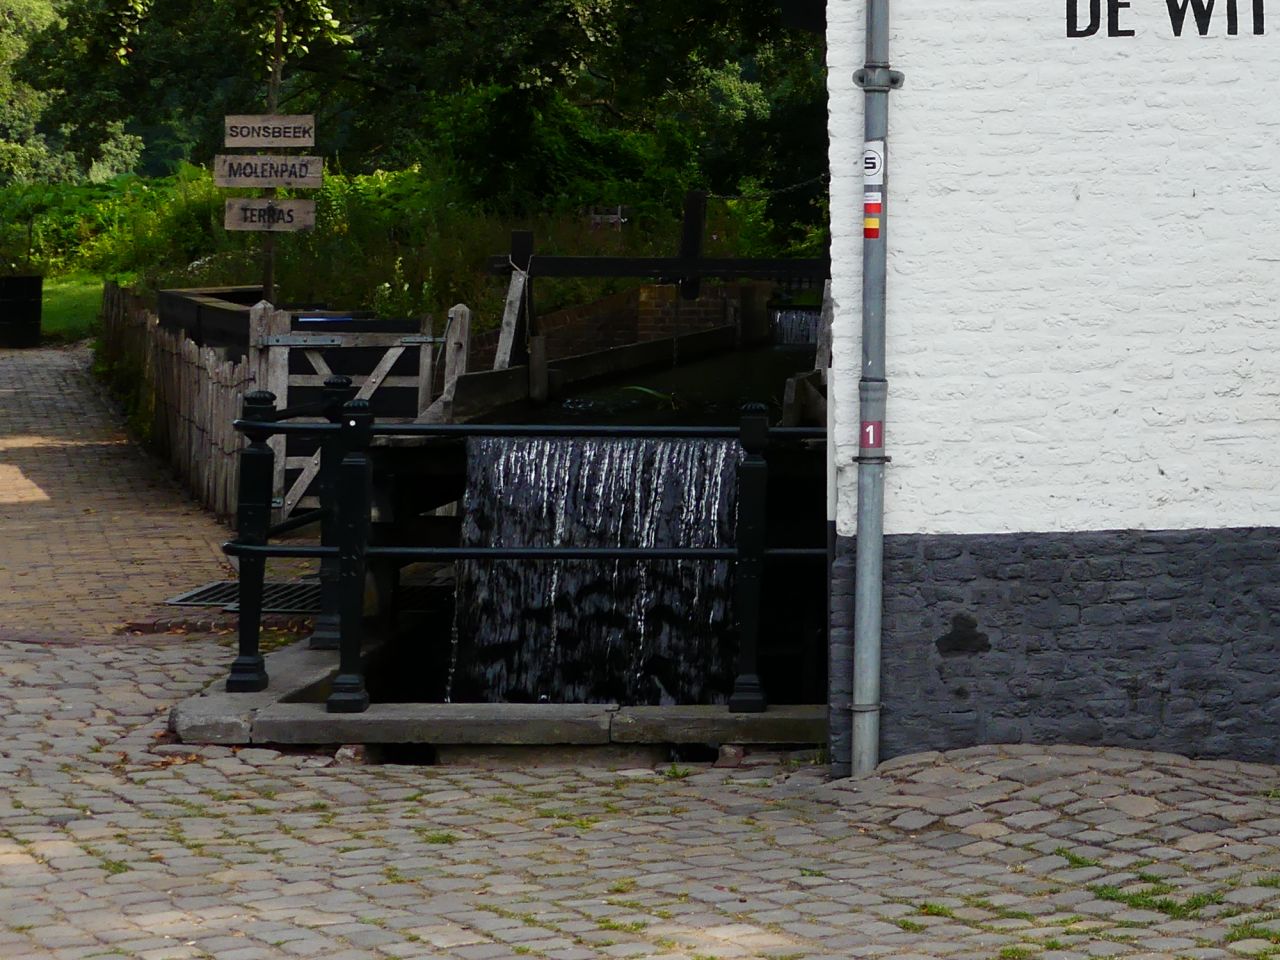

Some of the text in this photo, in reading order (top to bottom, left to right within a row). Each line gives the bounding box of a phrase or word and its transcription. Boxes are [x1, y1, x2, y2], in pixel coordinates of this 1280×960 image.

[229, 125, 313, 139] SONSBEEK
[228, 162, 309, 178] MOLENPAD
[241, 206, 294, 224] TERRAS
[865, 424, 874, 445] 1
